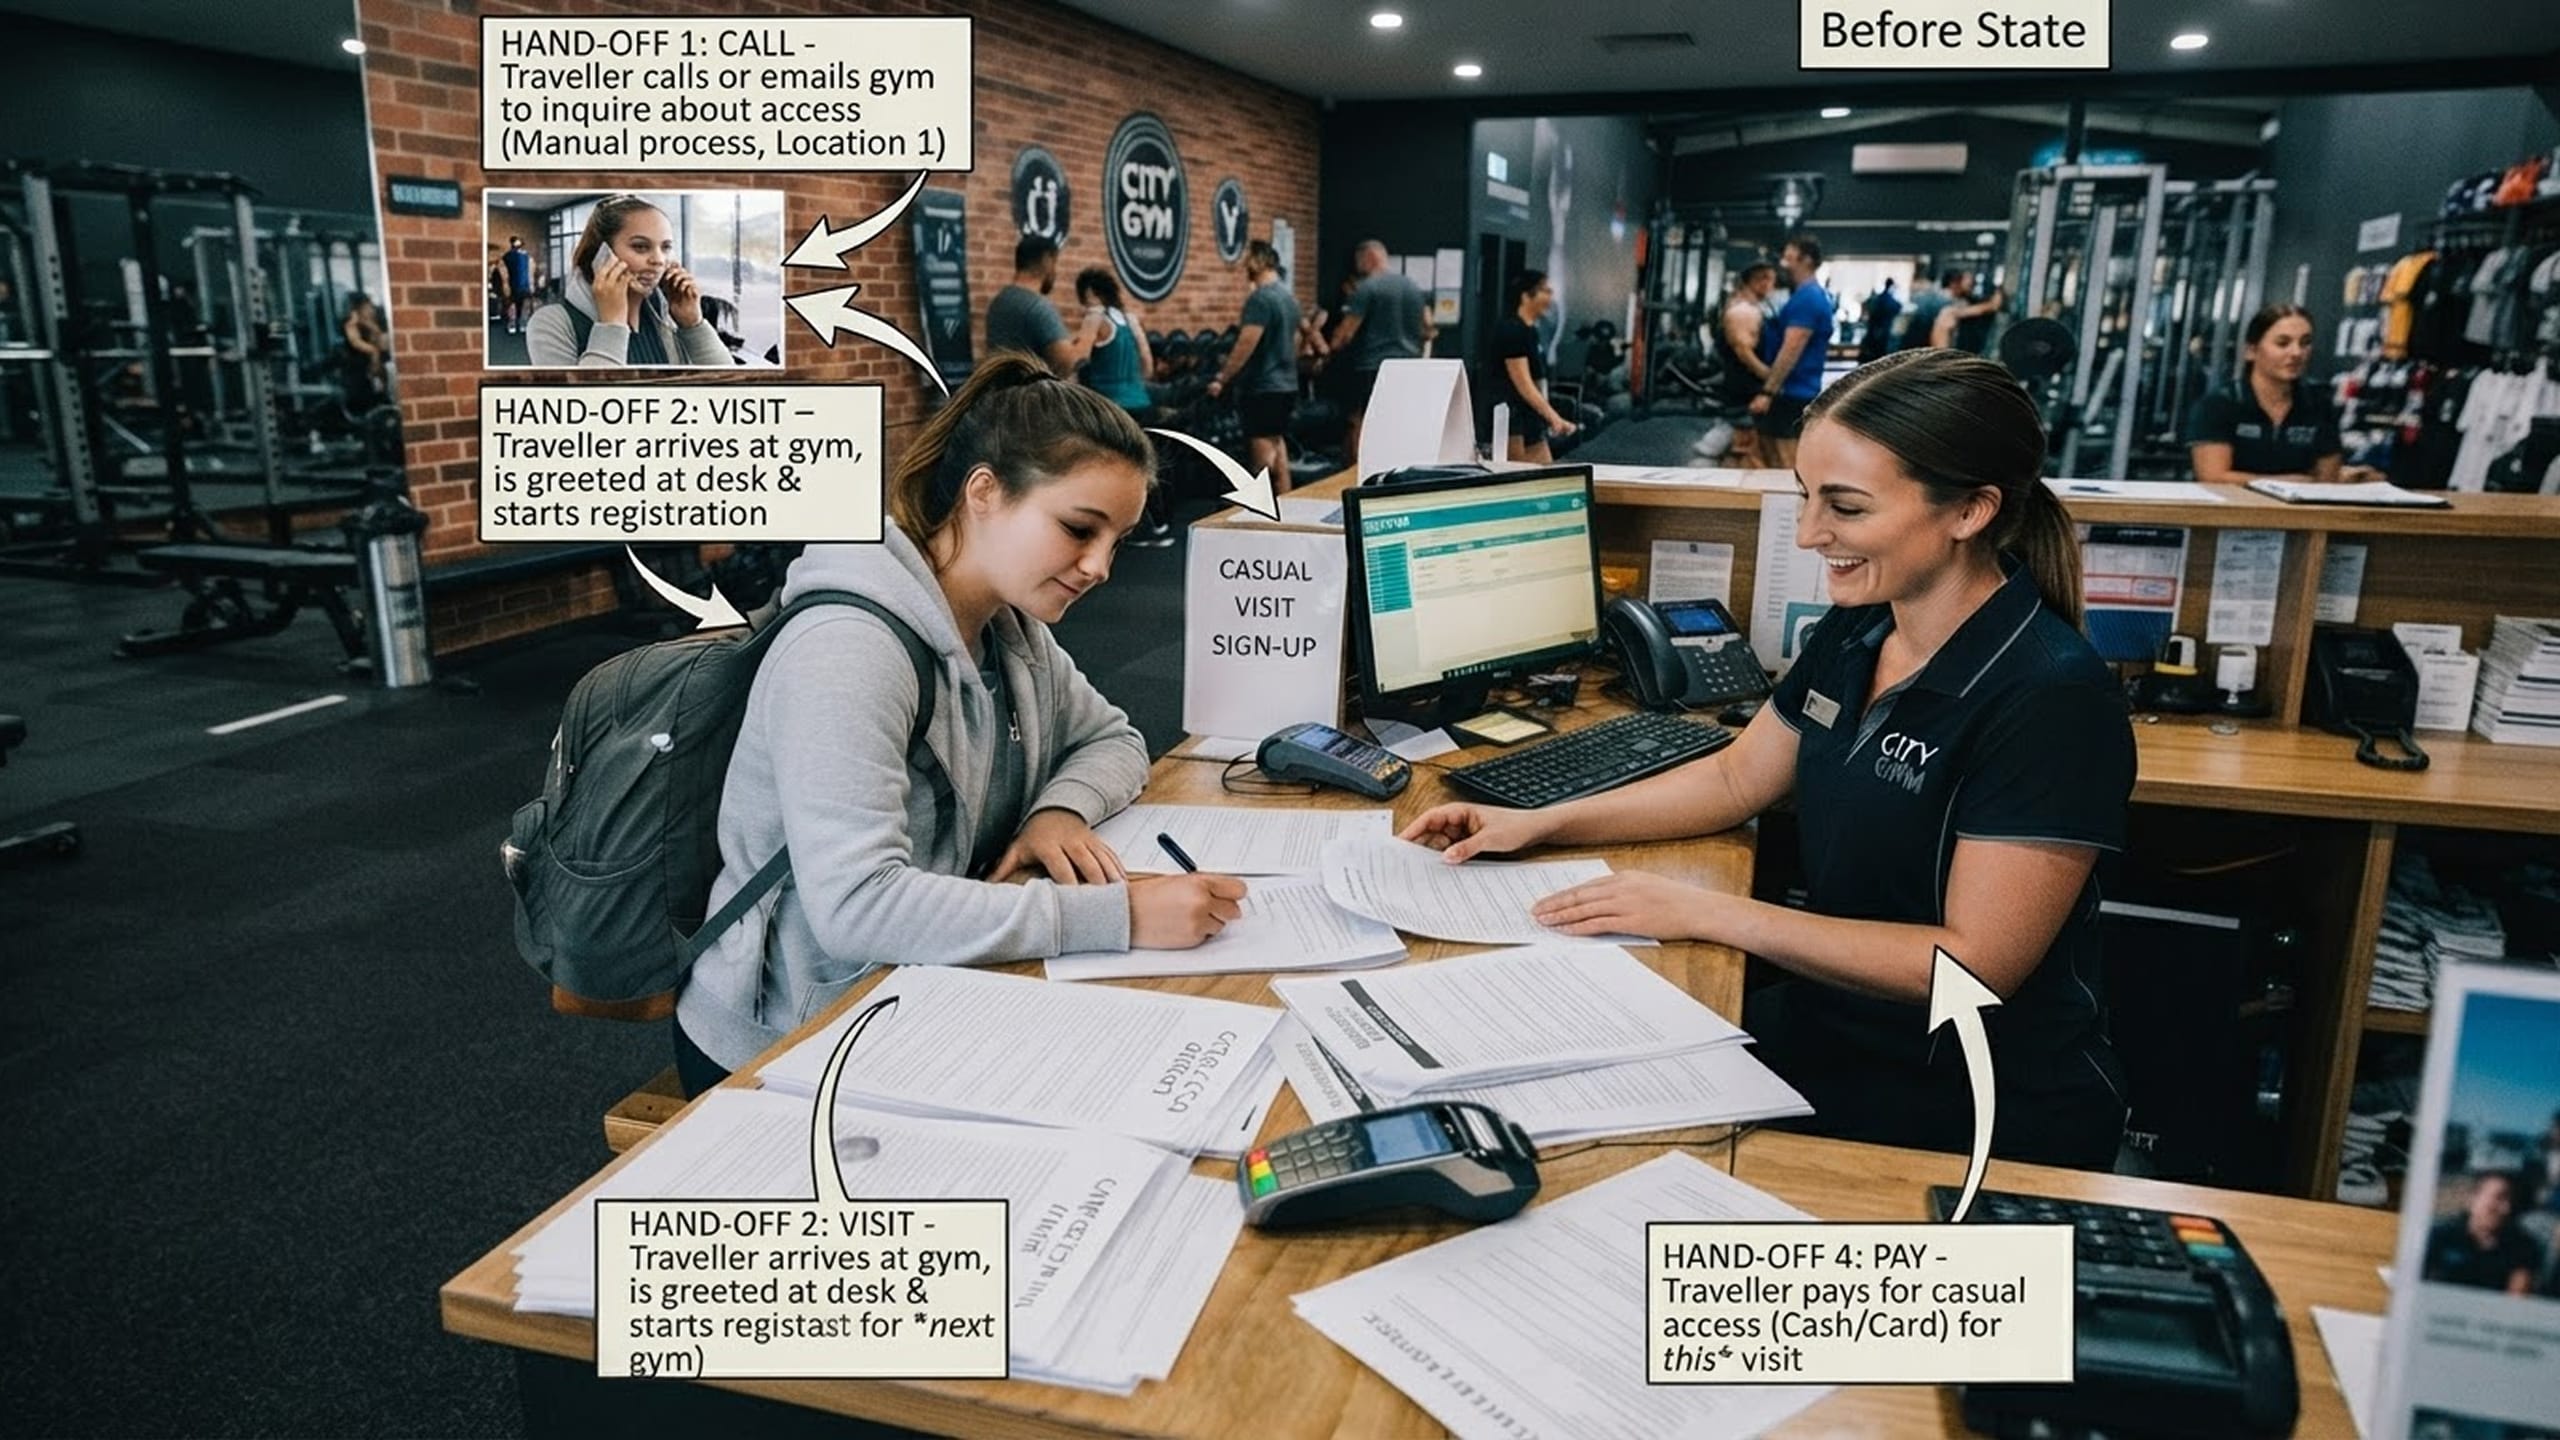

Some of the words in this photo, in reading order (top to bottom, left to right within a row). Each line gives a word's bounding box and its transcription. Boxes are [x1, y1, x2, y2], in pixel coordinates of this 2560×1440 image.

[1121, 161, 1177, 201] CITY
[1121, 201, 1174, 240] GYM
[1219, 558, 1313, 582] CASUAL
[1234, 595, 1296, 618] VISIT
[1211, 633, 1317, 658] SIGN-UP
[1880, 732, 1940, 766] CITY
